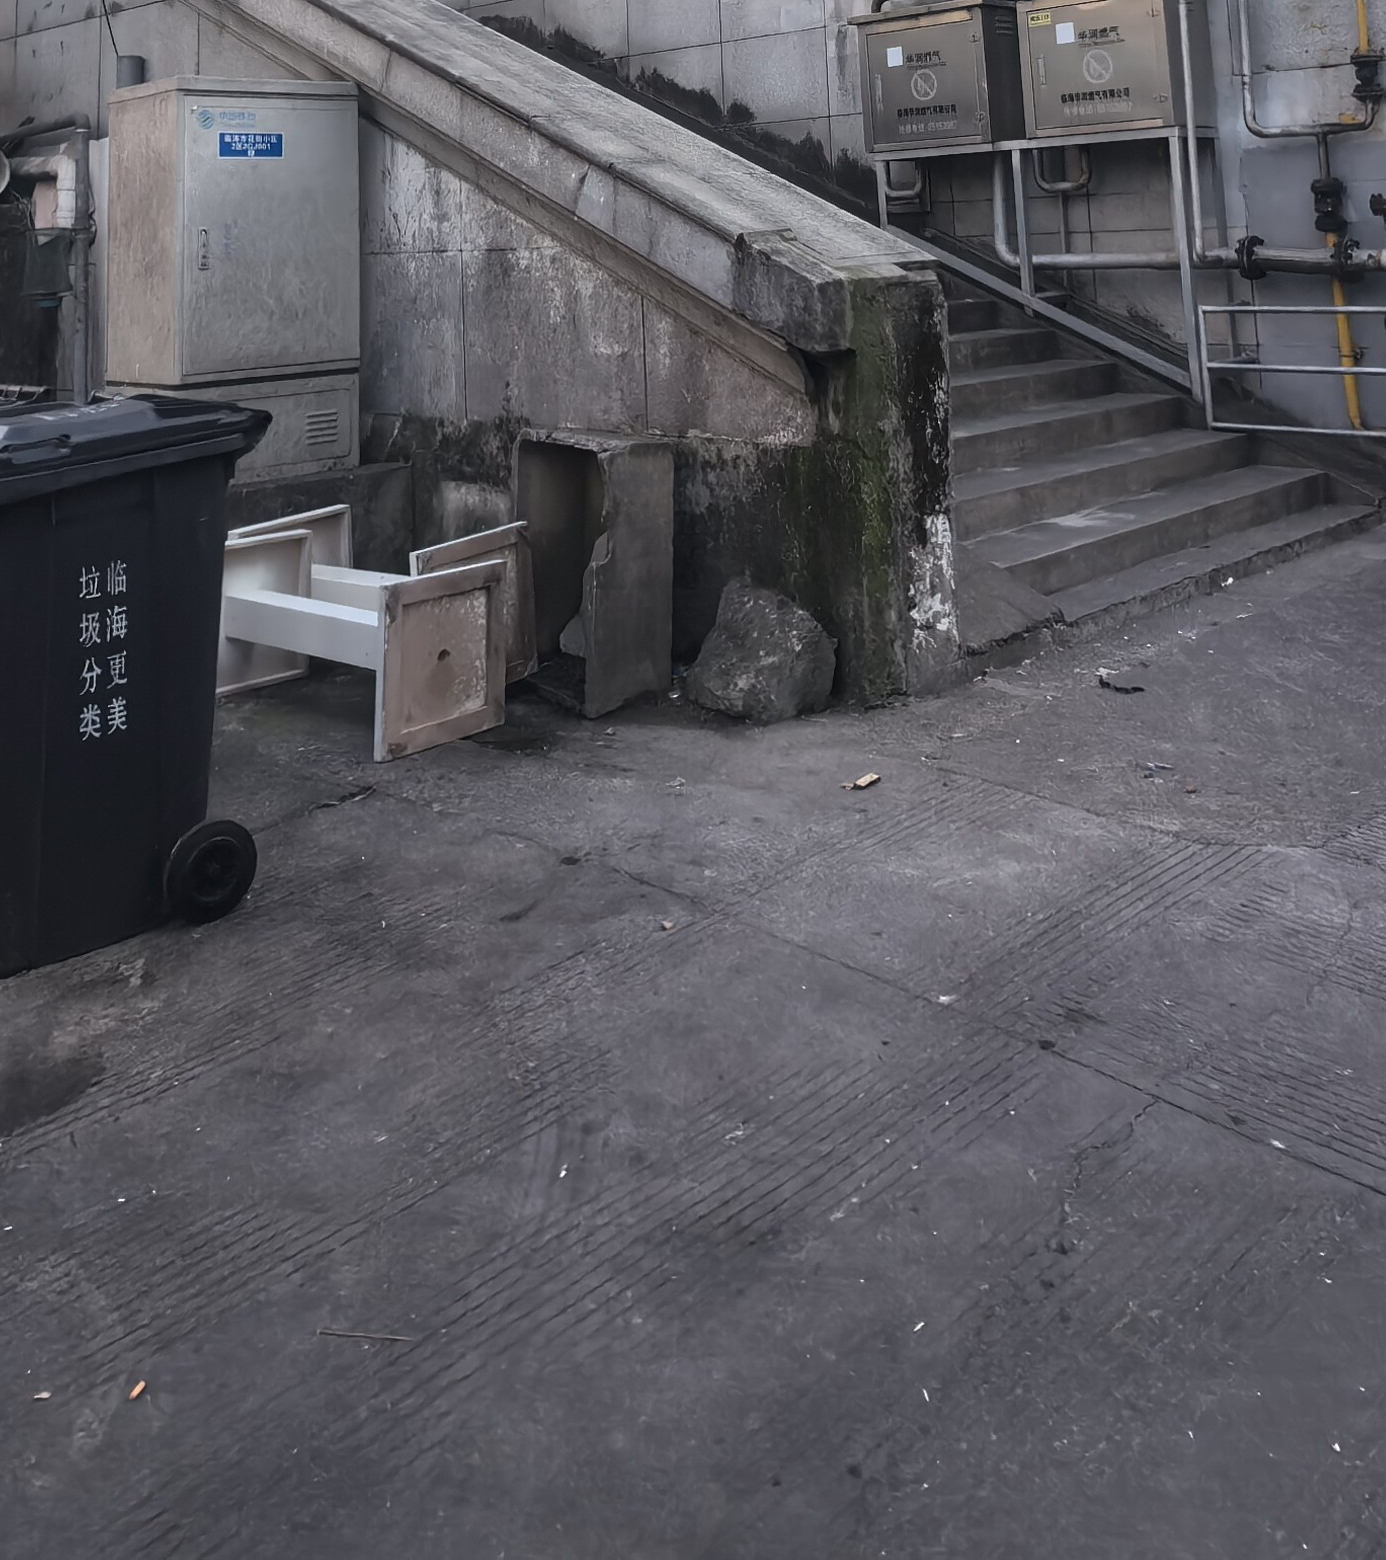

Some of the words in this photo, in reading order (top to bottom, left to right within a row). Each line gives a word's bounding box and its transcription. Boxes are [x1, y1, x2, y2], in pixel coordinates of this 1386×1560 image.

[79, 566, 102, 741] 垃圾分类
[106, 559, 128, 735] 临海更美
